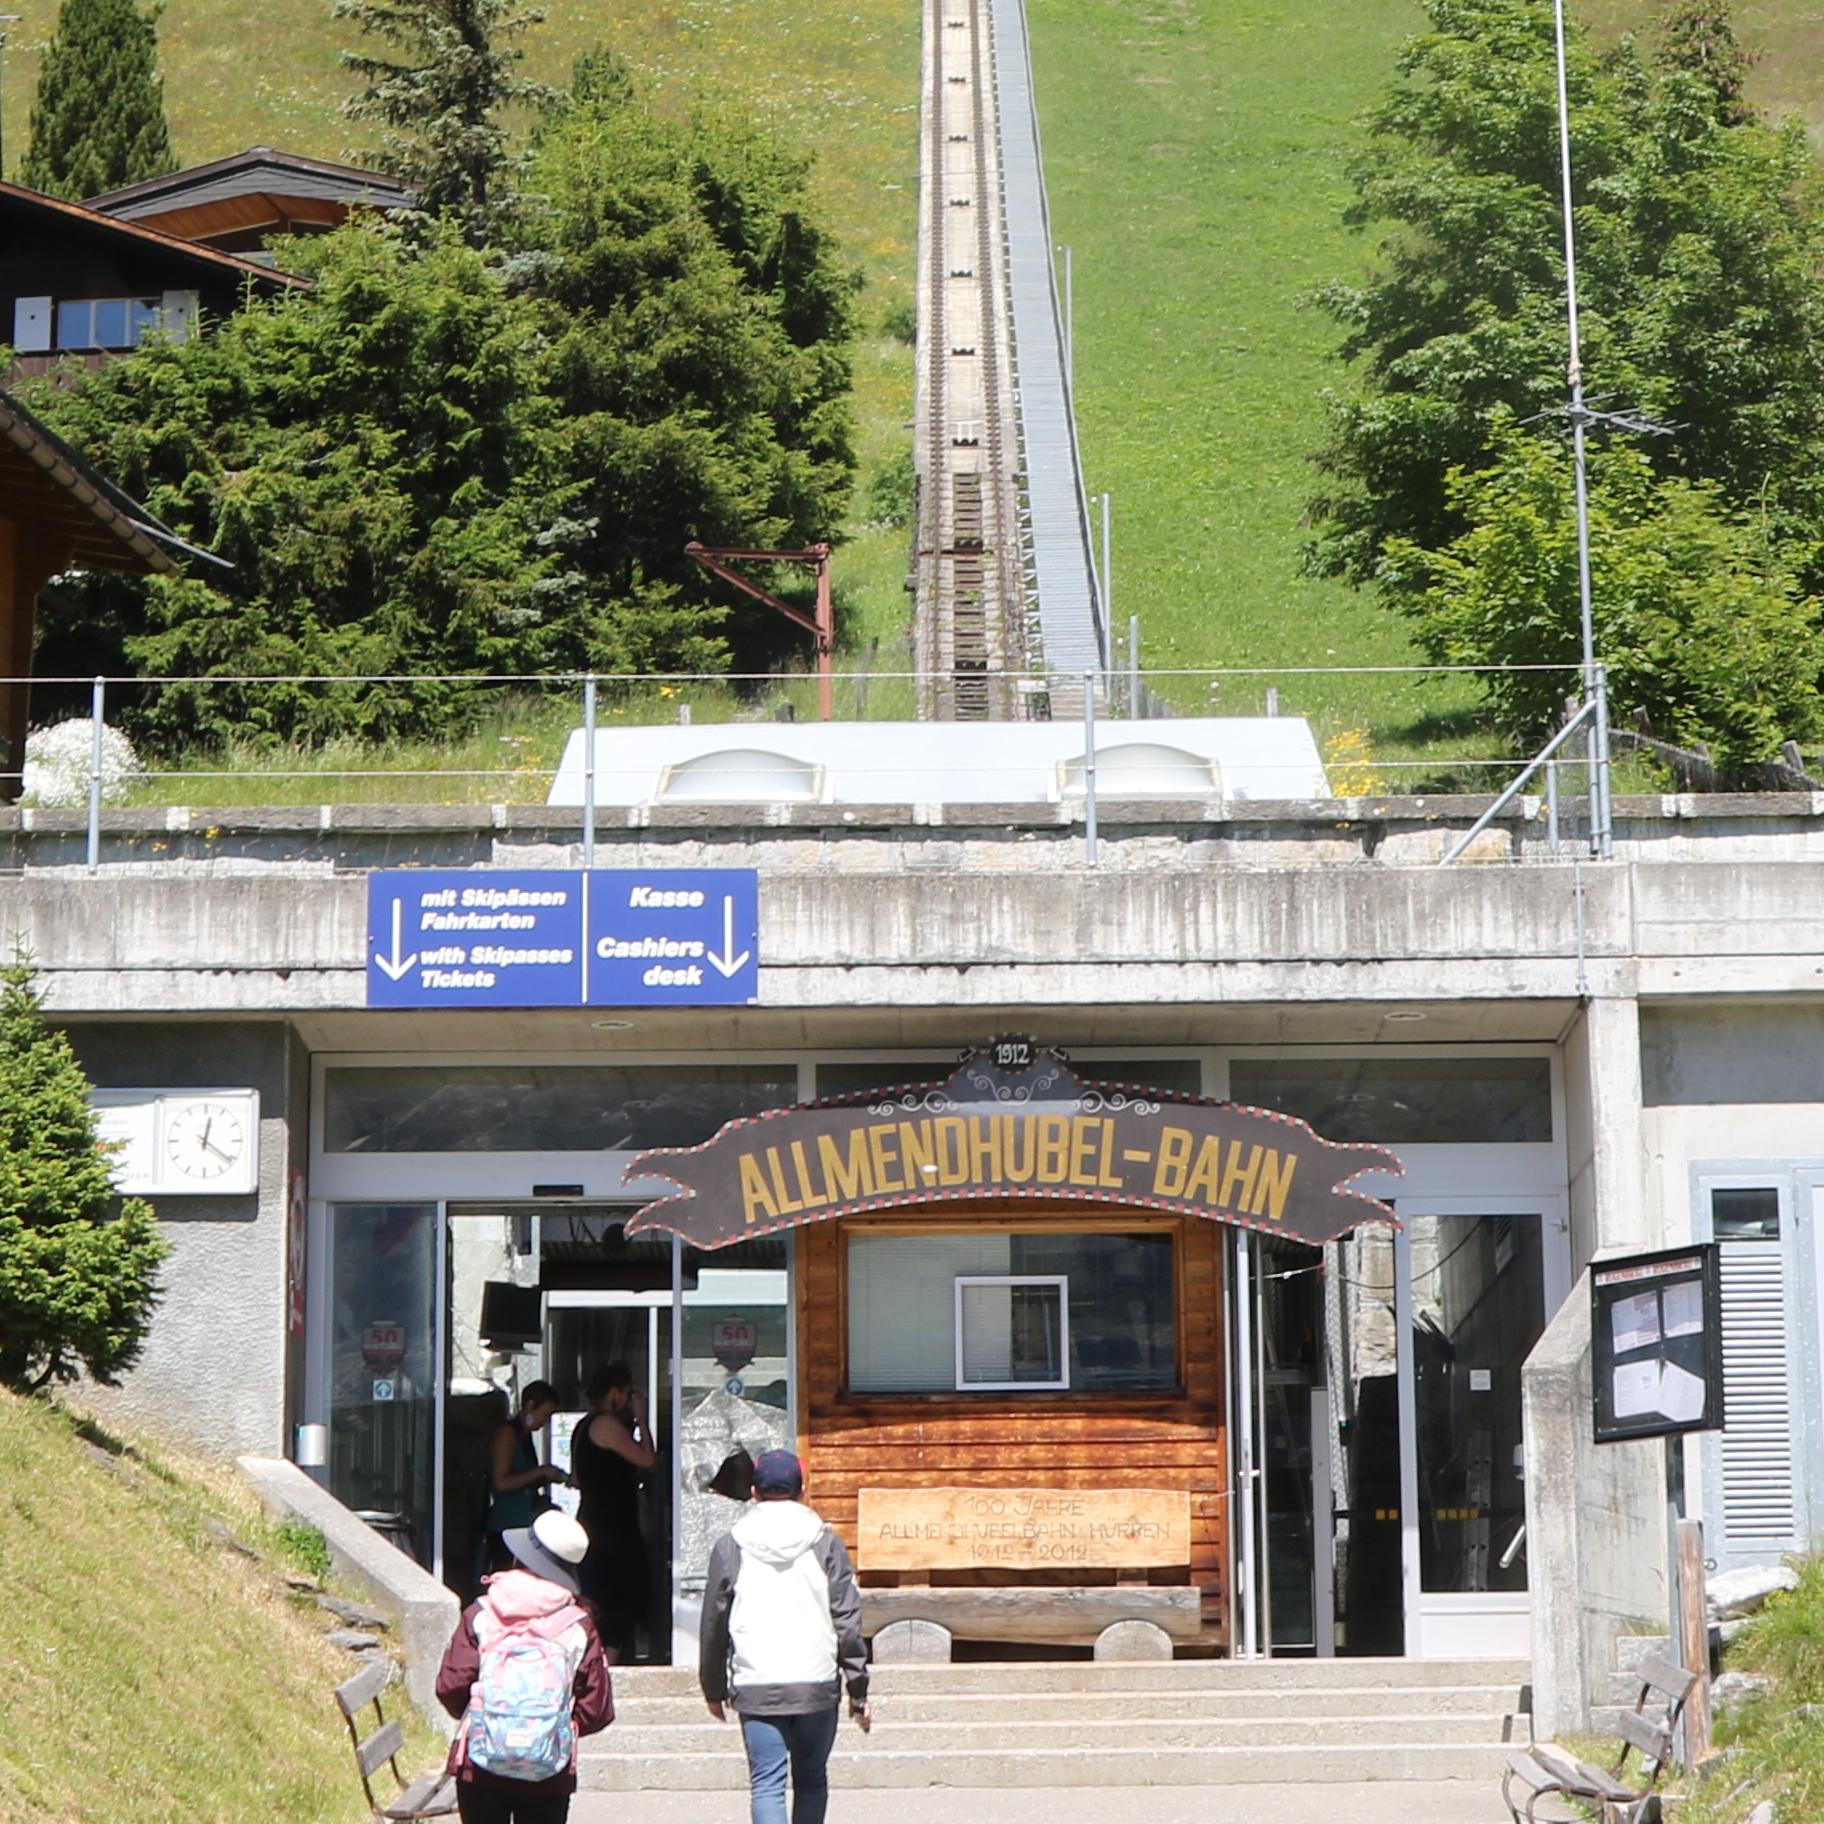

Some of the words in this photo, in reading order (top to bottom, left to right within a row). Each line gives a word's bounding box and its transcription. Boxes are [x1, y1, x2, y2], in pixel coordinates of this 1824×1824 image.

[421, 889, 458, 908] mit
[461, 888, 566, 910] Skipässen
[630, 887, 704, 908] Kasse
[421, 912, 535, 931] Fahrkarten
[421, 946, 465, 965] with
[471, 946, 572, 968] Skipasses
[596, 937, 704, 958] Cashiers
[421, 970, 495, 988] Tickets
[642, 966, 702, 987] desk
[995, 1043, 1030, 1065] 1912
[738, 1114, 1298, 1224] ALLMENDHUBEL-BAHN
[965, 1495, 1005, 1516] 100
[1014, 1495, 1084, 1516] JAHRE
[880, 1522, 1075, 1540] ALLMENDHUBELBAHN
[1090, 1519, 1170, 1539] MÜRREN
[1039, 1543, 1087, 1560] 2012
